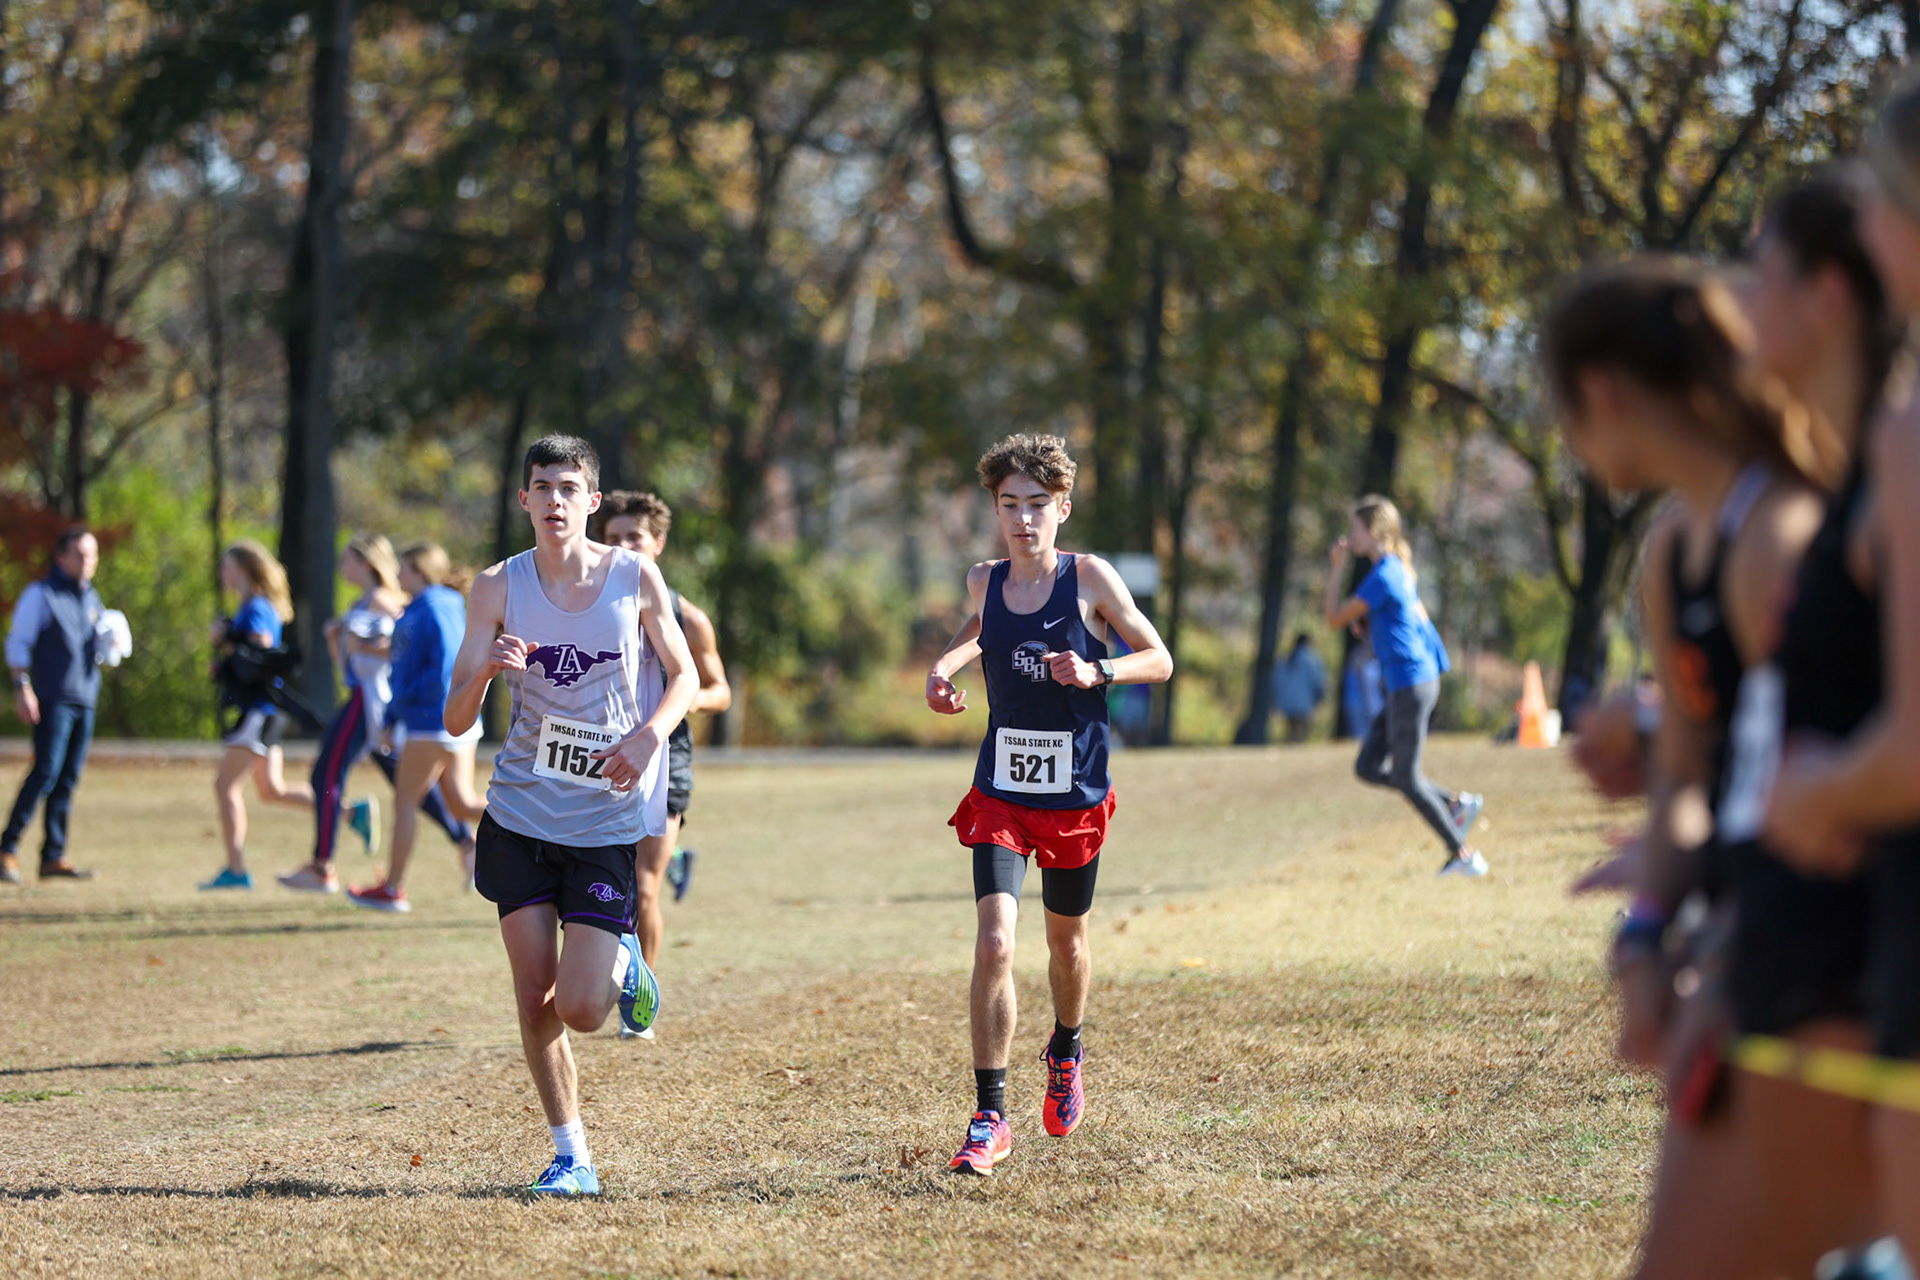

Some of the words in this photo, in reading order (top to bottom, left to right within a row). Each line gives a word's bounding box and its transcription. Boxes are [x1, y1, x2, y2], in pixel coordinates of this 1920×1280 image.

[553, 645, 585, 674] LA
[1014, 650, 1045, 680] SBA
[550, 723, 576, 738] TMSAA
[577, 730, 600, 742] STATE
[601, 733, 613, 744] XC
[1004, 736, 1027, 747] TSSAA
[1028, 738, 1051, 748] STATE
[1052, 739, 1063, 748] XC
[546, 740, 607, 780] 1152
[1009, 753, 1056, 784] 521
